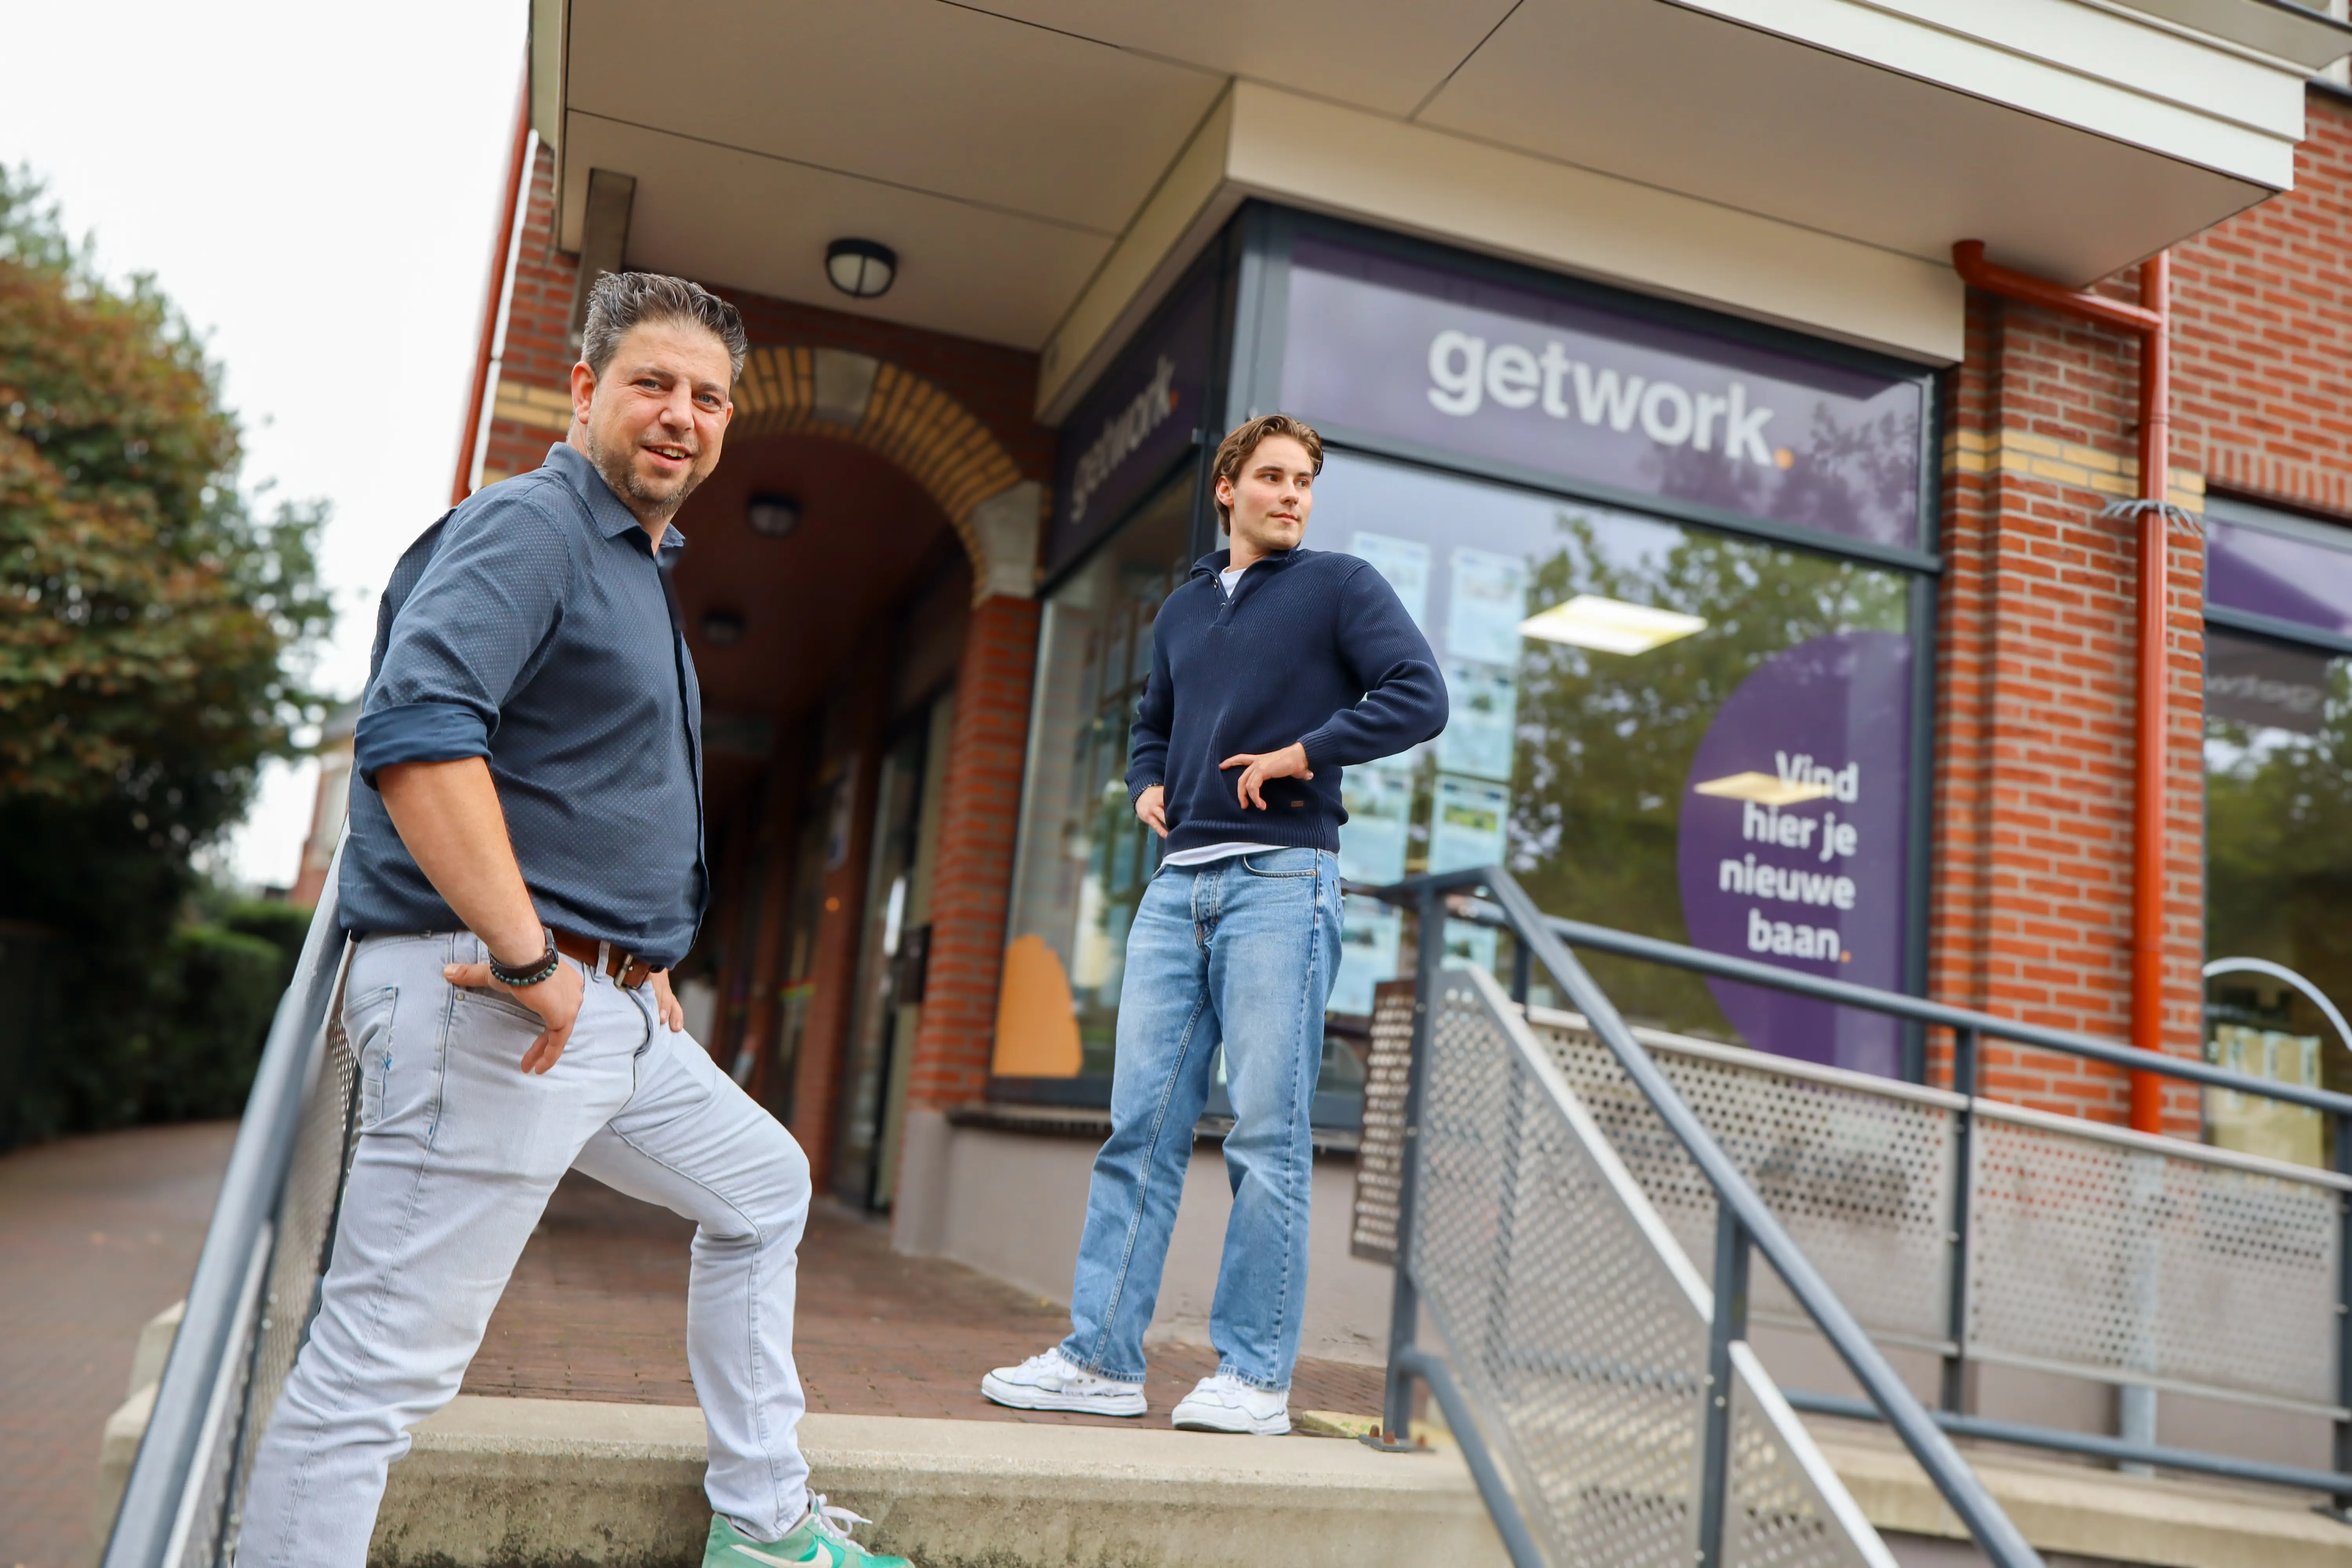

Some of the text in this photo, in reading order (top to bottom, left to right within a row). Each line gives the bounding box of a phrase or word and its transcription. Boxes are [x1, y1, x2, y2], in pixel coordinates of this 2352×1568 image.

[1427, 330, 1794, 468] getwork.
[1775, 750, 1858, 802] Vind
[1743, 800, 1857, 862] hier je
[1719, 853, 1856, 909] nieuwe
[1748, 907, 1851, 962] baan.
